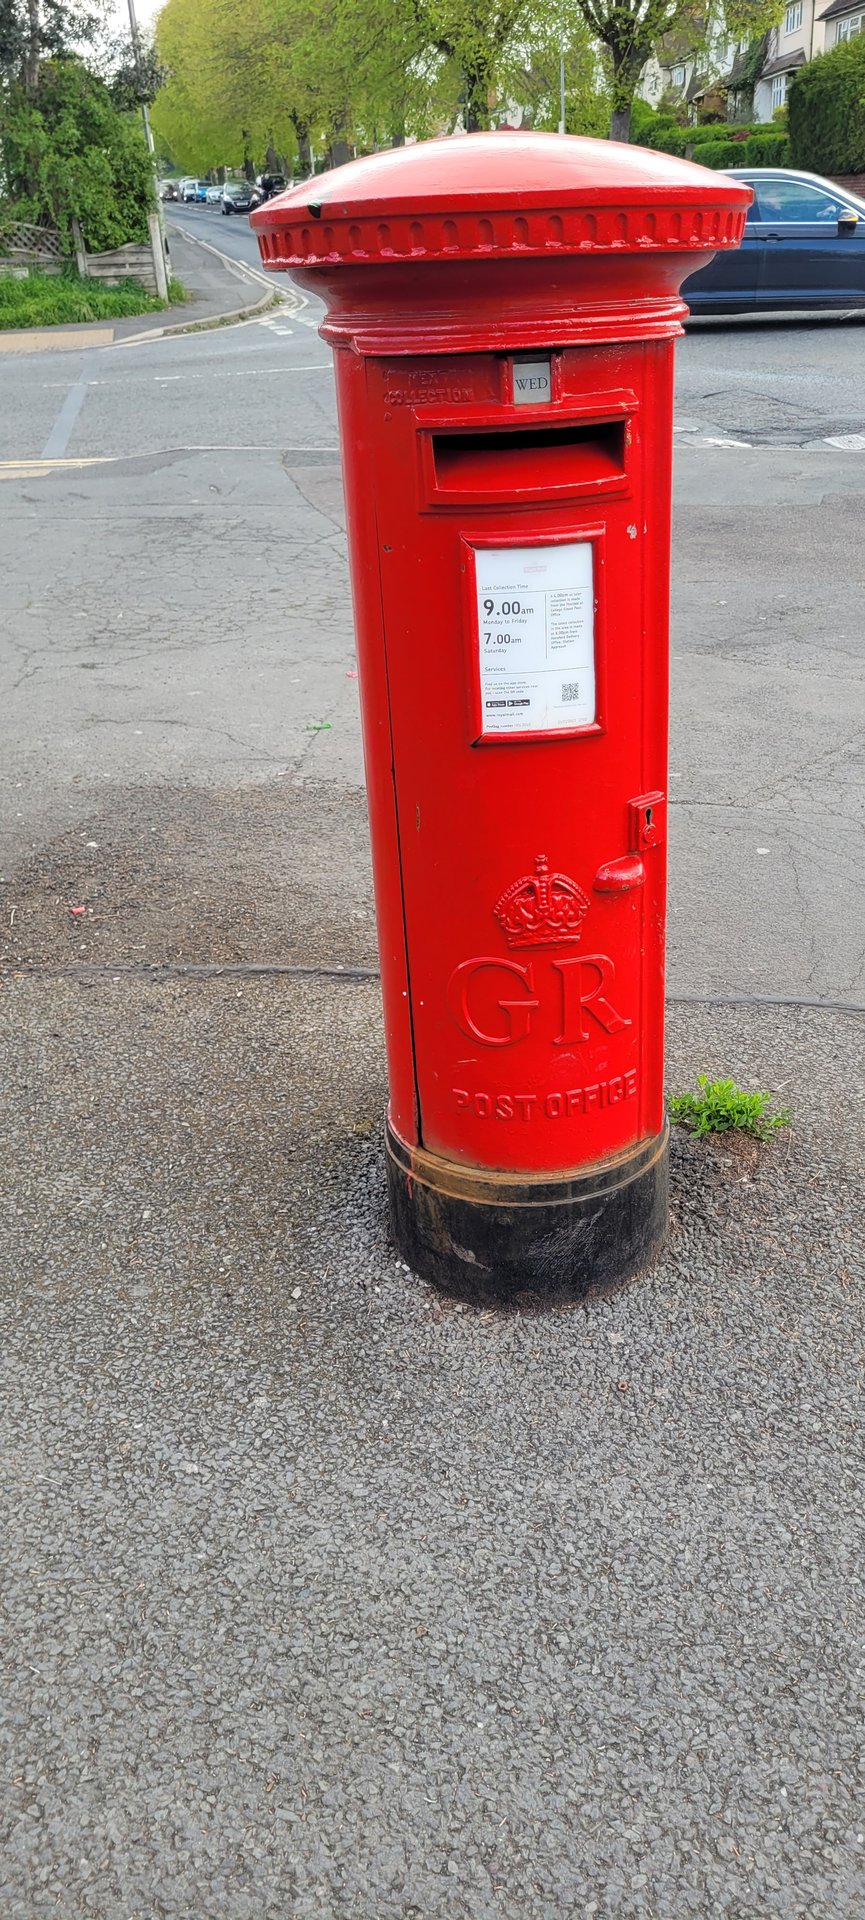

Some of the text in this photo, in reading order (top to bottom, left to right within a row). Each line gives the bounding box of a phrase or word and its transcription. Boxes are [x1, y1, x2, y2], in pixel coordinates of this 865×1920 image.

[516, 376, 548, 390] WED
[483, 598, 534, 616] 9.00am
[484, 632, 522, 644] 7.00am
[448, 954, 632, 1047] GR
[452, 1068, 637, 1121] POST OFFICE
